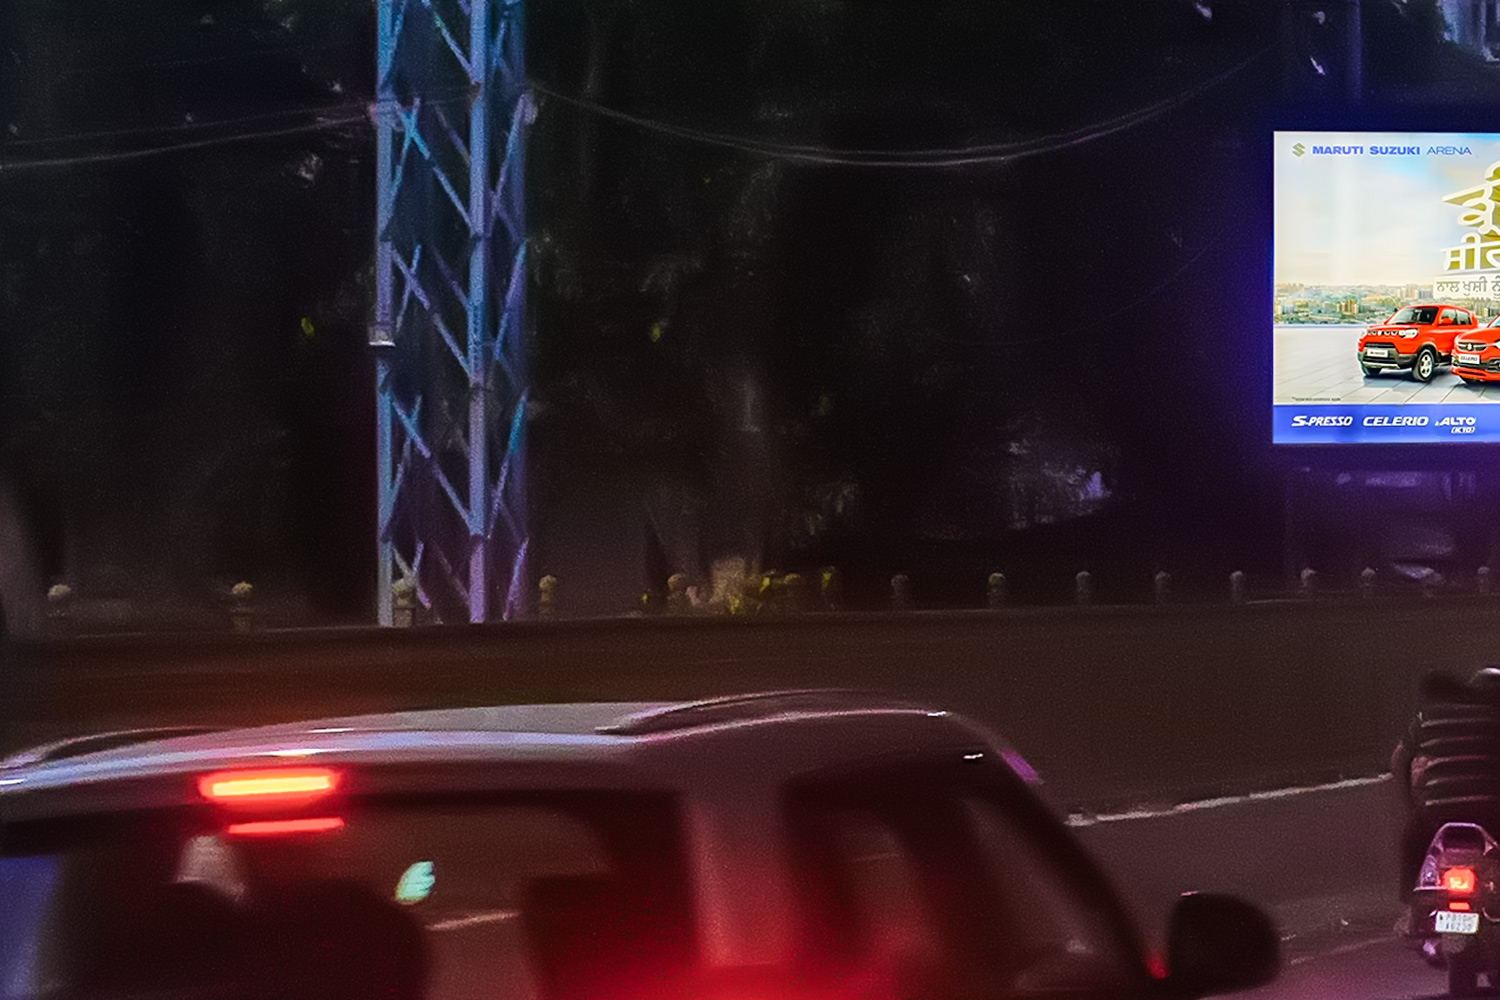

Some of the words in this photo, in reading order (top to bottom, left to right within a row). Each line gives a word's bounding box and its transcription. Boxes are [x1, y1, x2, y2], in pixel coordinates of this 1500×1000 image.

[1312, 145, 1364, 155] MARUTI
[1370, 145, 1421, 155] SUZUKI
[1426, 146, 1472, 155] ARENA
[1291, 415, 1353, 426] S-PRESSO
[1363, 416, 1429, 426] CELERIO
